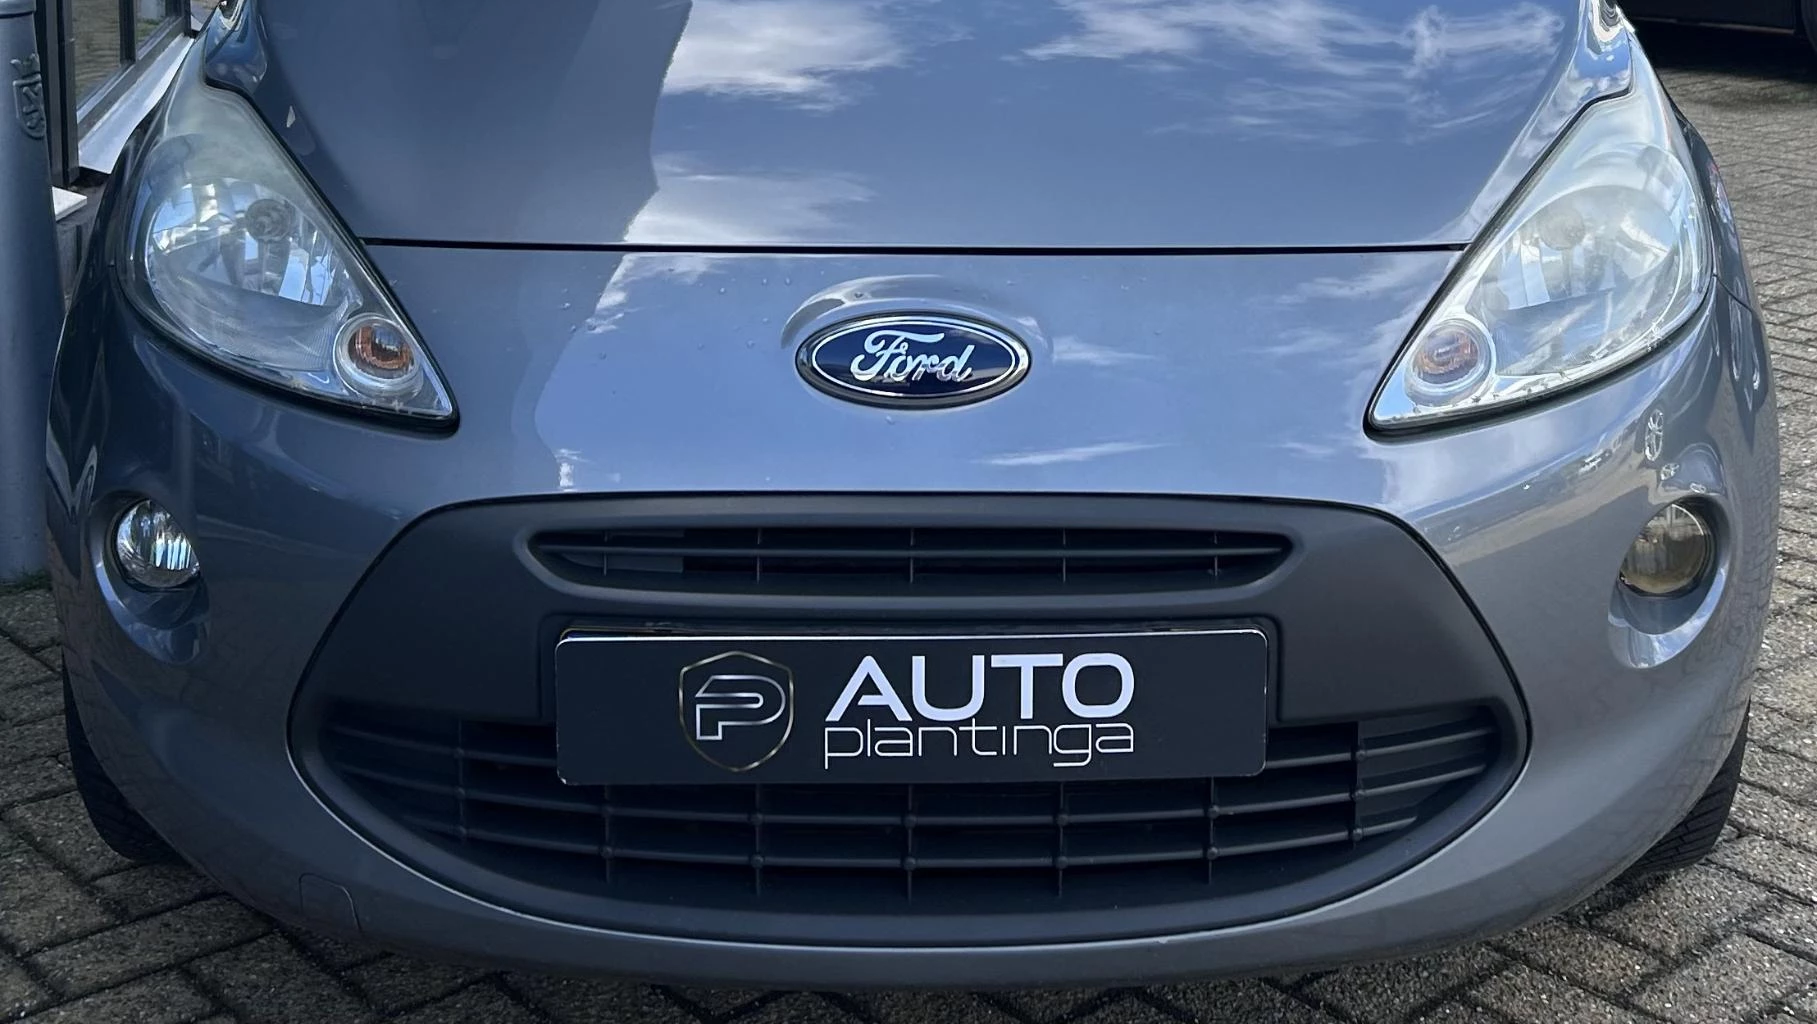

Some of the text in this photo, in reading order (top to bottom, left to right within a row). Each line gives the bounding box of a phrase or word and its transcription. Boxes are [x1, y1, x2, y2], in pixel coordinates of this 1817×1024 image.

[850, 329, 975, 382] Ford
[825, 652, 1135, 721] AUTO
[824, 718, 1135, 769] plantinga
